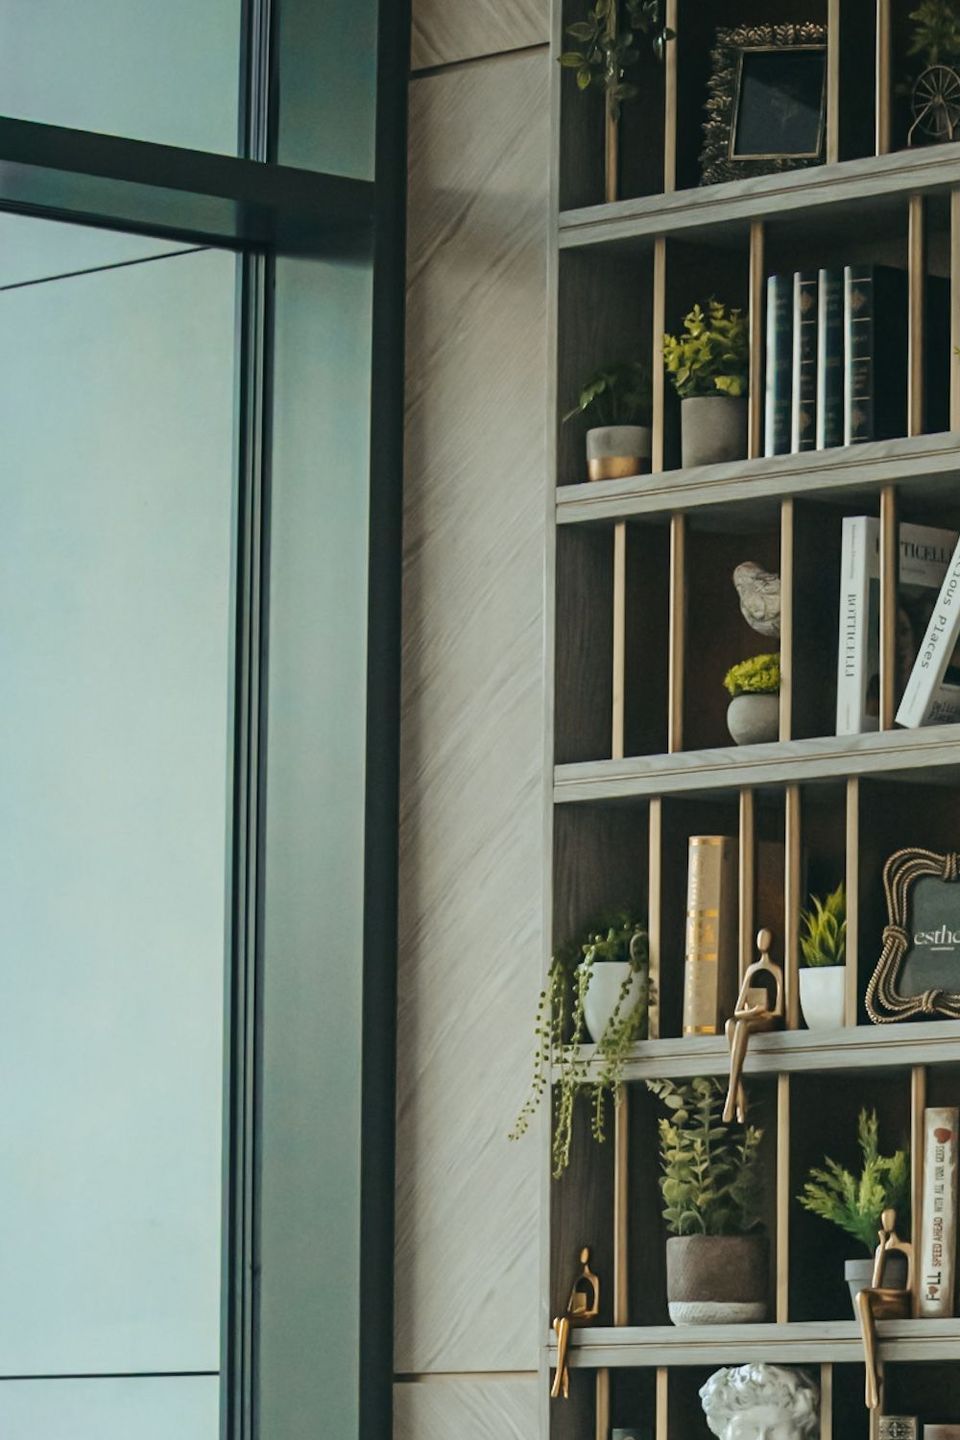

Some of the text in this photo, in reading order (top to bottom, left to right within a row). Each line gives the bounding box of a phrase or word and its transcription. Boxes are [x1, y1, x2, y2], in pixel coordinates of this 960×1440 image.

[845, 593, 857, 677] BOTTICELLI
[920, 614, 947, 670] Places
[933, 1215, 944, 1242] AHEAD
[931, 1242, 943, 1268] SPEED
